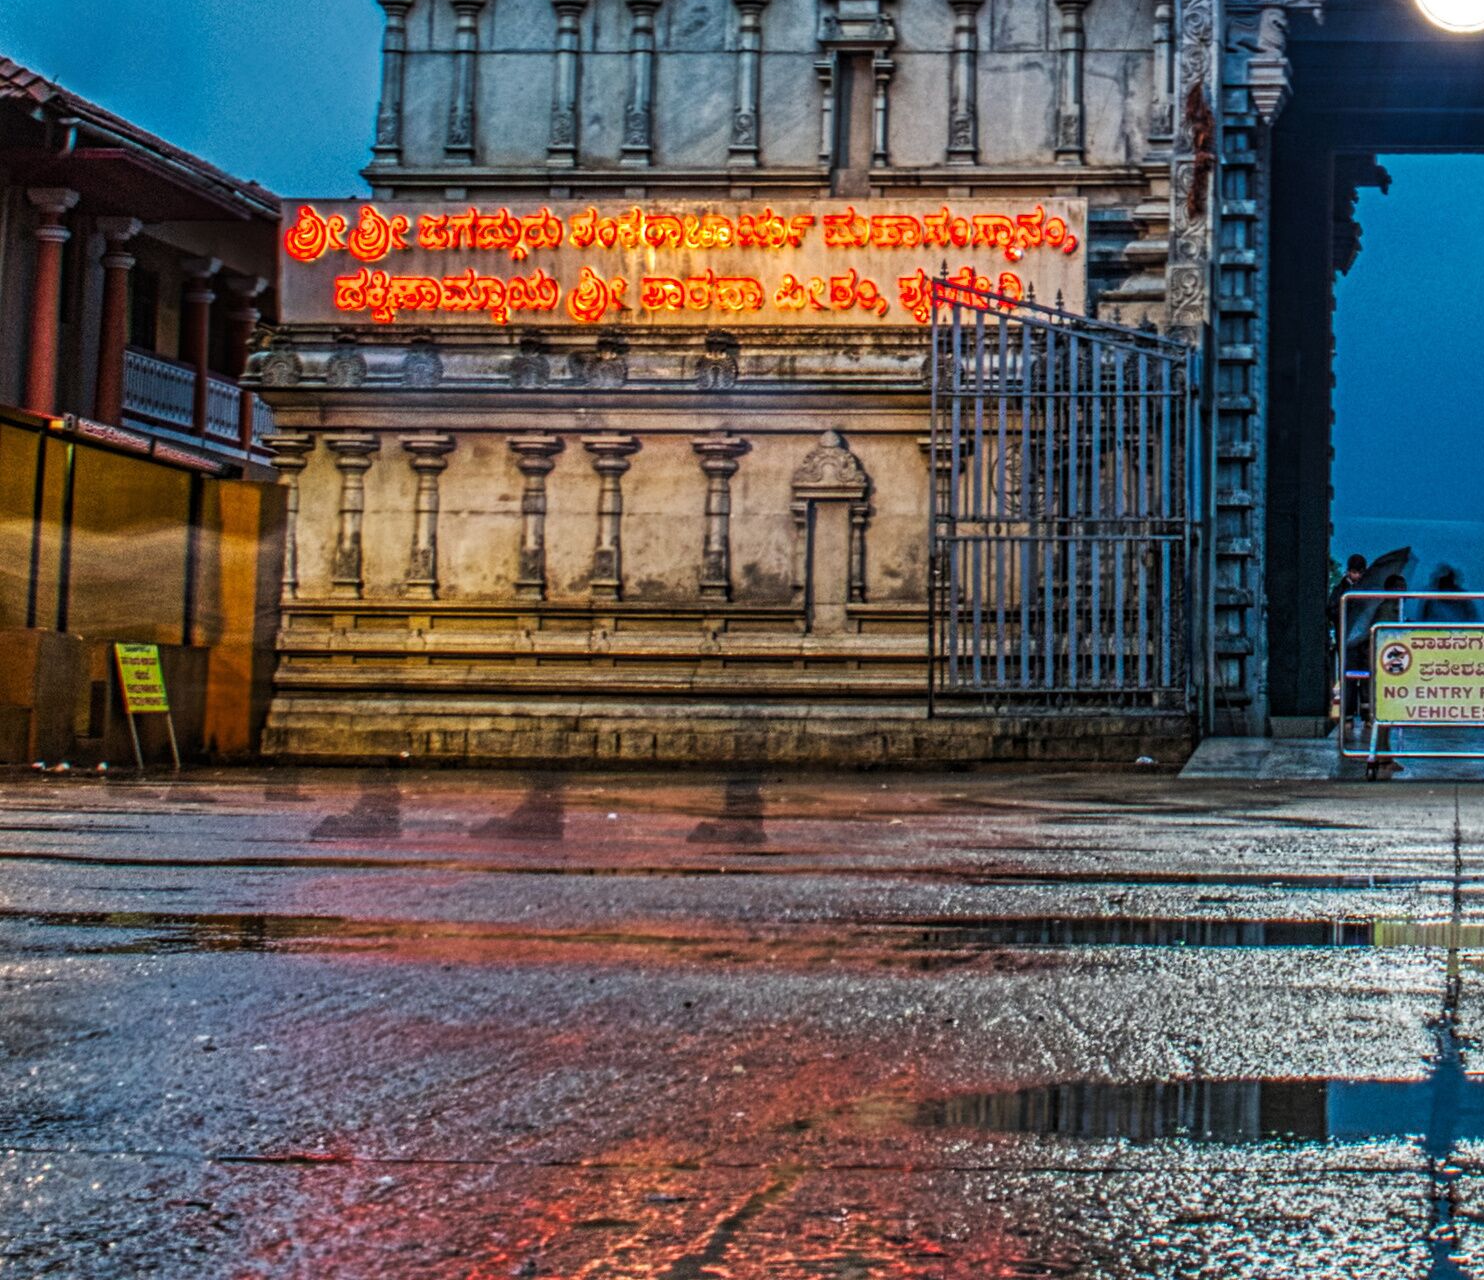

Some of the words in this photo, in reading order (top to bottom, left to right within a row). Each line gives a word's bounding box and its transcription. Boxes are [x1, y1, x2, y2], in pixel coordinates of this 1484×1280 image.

[284, 205, 347, 262] ಶ್ರೀ
[350, 205, 412, 262] ಶ್ರೀ
[567, 266, 629, 322] ಶ್ರೀ
[641, 268, 765, 311] ಶಾರದಾ
[1383, 686, 1409, 699] NO
[1415, 686, 1473, 699] ENTRY
